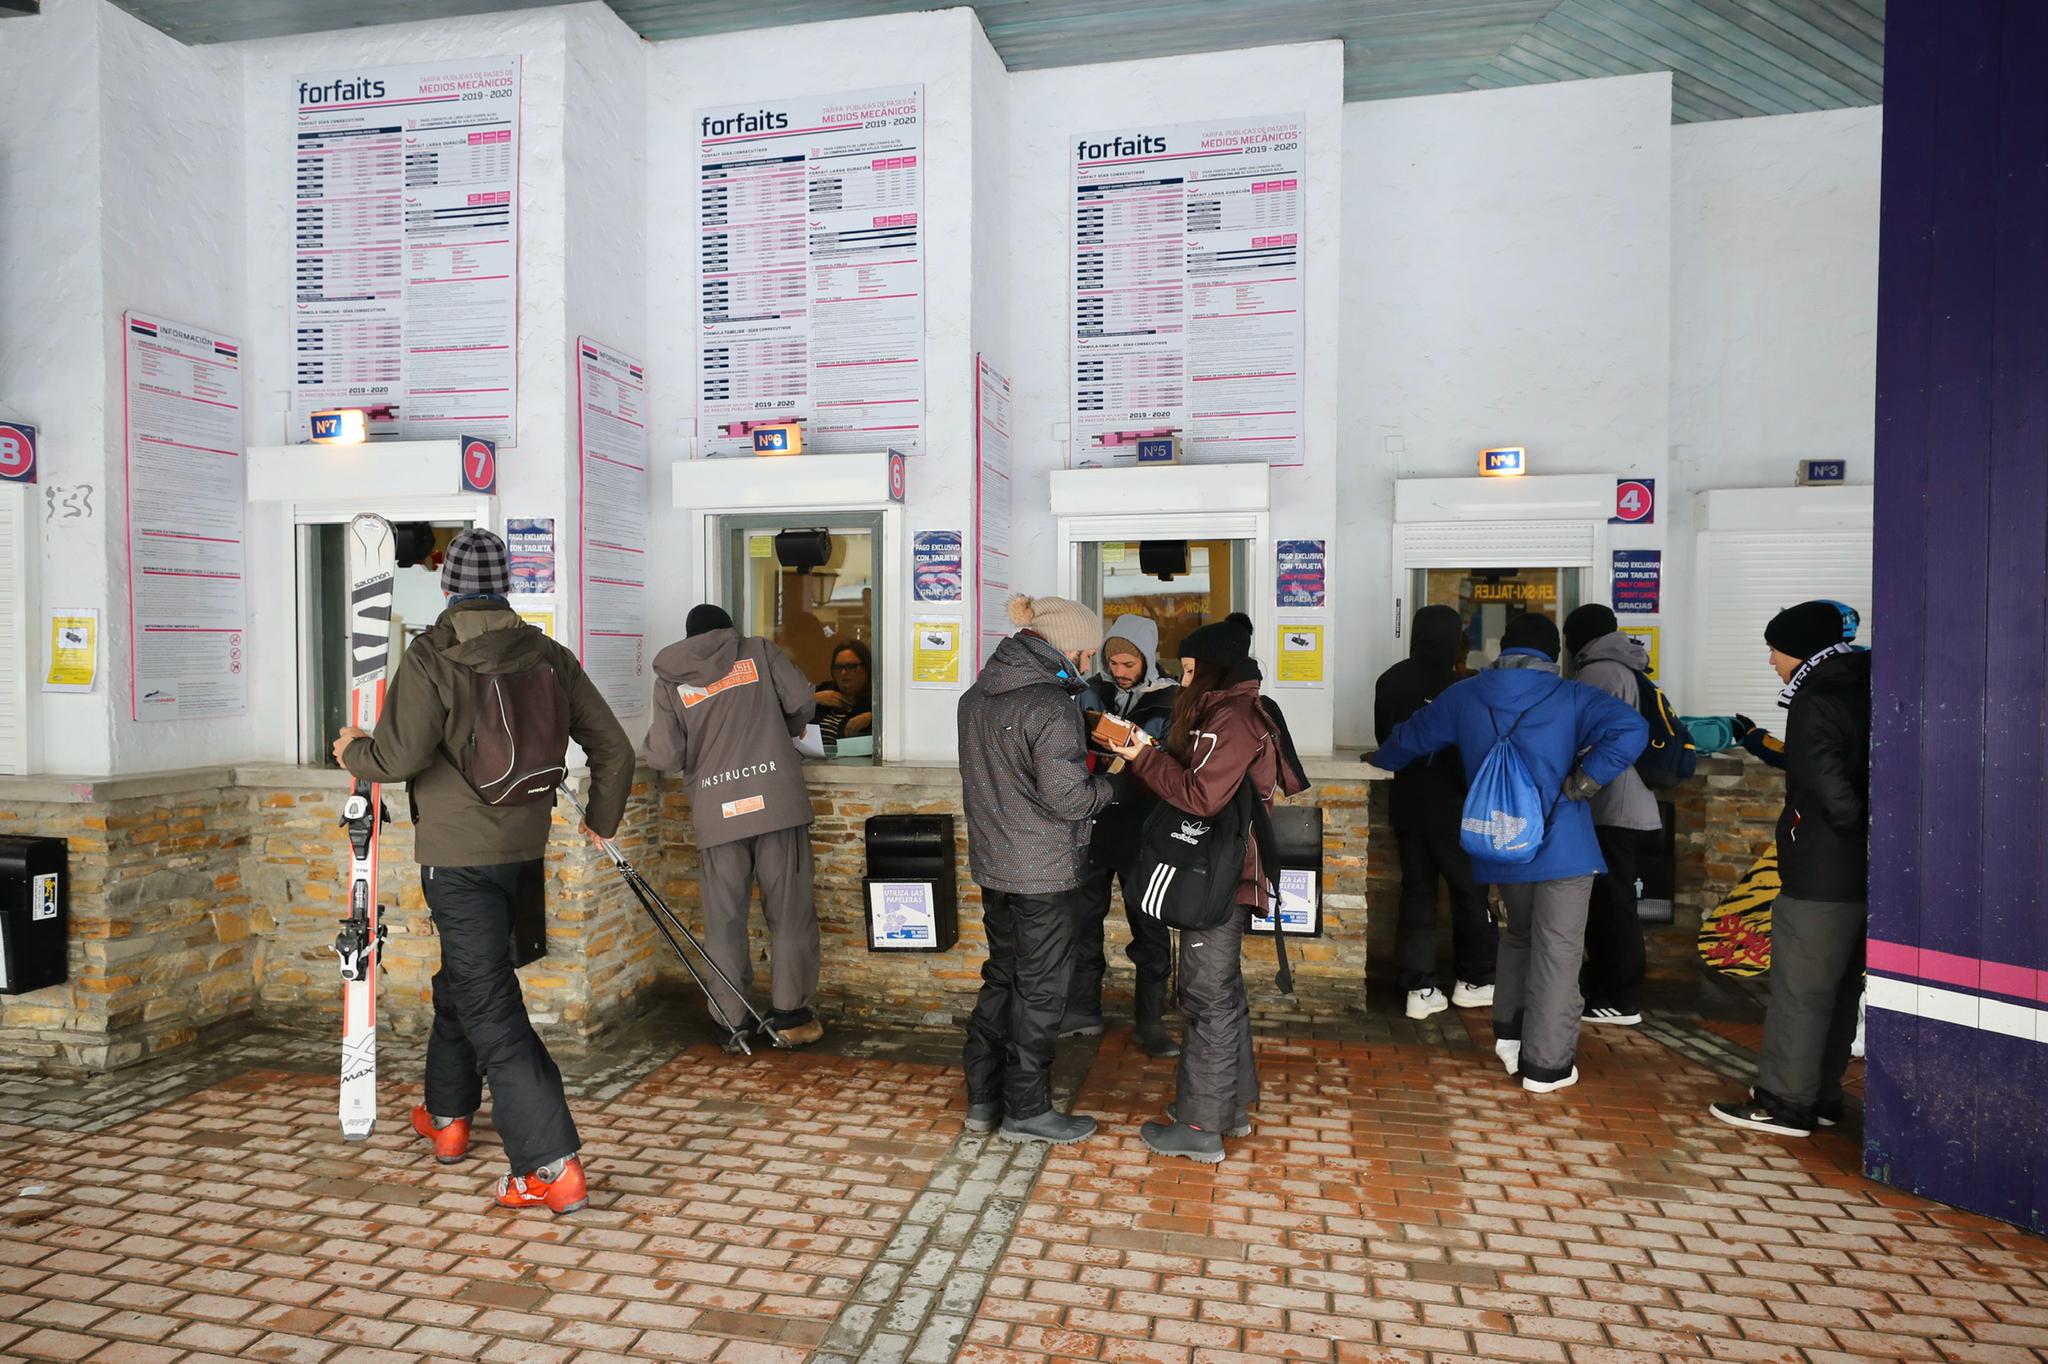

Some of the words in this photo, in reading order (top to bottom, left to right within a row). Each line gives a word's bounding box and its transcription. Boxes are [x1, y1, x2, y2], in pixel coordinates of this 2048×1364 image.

[299, 76, 386, 104] forfaits
[419, 82, 456, 95] MEDIOS
[462, 91, 483, 102] 2019
[490, 88, 513, 99] 2020
[701, 109, 788, 137] forfaits
[822, 111, 859, 124] MEDIOS
[865, 120, 887, 129] 2019
[893, 116, 916, 126] 2020
[1077, 133, 1167, 161] forfaits
[1201, 136, 1239, 149] MEDIOS
[1245, 145, 1267, 154] 2019
[1274, 142, 1298, 152] 2020
[159, 326, 213, 346] INFORMACIÓN
[472, 451, 487, 478] 7
[892, 463, 901, 490] 6
[1619, 490, 1641, 512] 4
[509, 544, 522, 552] CON
[524, 544, 552, 553] TARJETA
[915, 543, 930, 551] PAGO
[931, 543, 960, 551] EXCLUSIVO
[916, 554, 930, 562] CON
[931, 554, 959, 562] TARJETA
[1295, 552, 1324, 560] EXCLUSIVO
[1280, 562, 1293, 570] CON
[1295, 562, 1322, 570] TARJETA
[1614, 561, 1629, 569] PAGO
[1630, 561, 1660, 569] EXCLUSIVO
[354, 571, 391, 589] salomon
[1615, 571, 1629, 579] CON
[1630, 571, 1658, 579] TARJETA
[514, 581, 548, 590] GRACIAS
[920, 588, 955, 596] GRACIAS
[1283, 595, 1318, 603] GRACIAS
[1617, 602, 1653, 610] GRACIAS
[700, 760, 777, 790] INSTRUCTOR
[1170, 831, 1199, 846] adidas
[884, 889, 909, 897] UTILIZA
[911, 889, 924, 897] LAS
